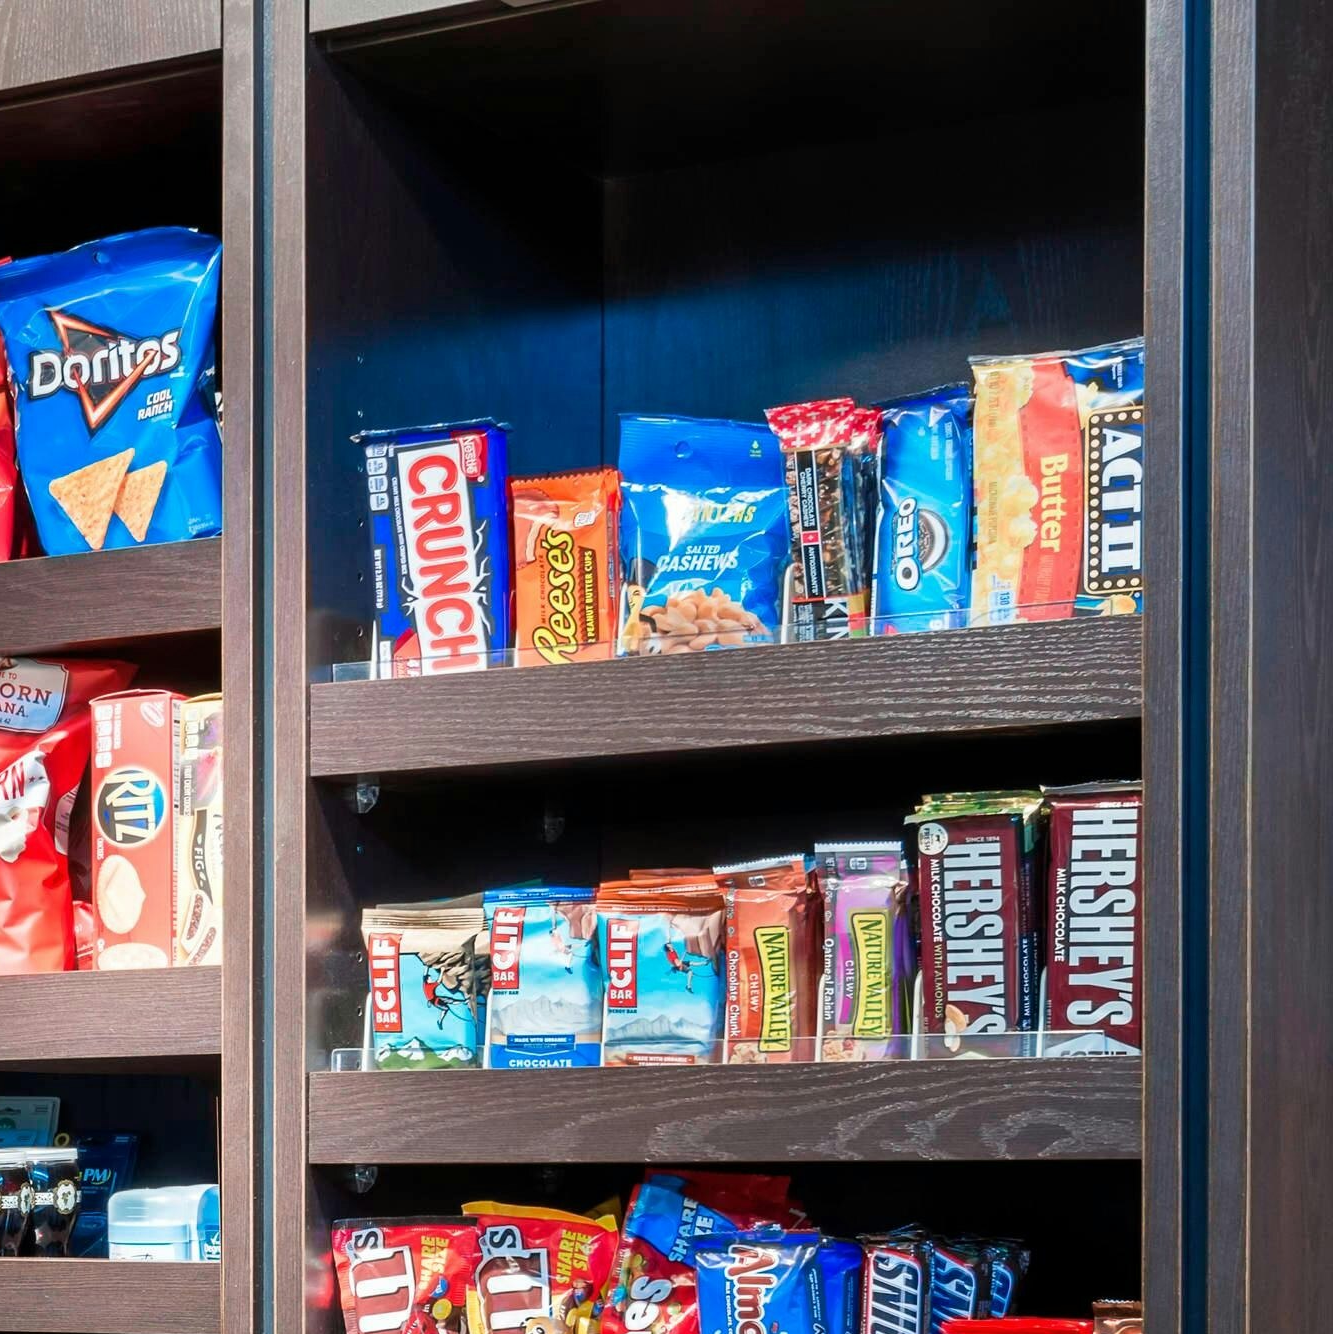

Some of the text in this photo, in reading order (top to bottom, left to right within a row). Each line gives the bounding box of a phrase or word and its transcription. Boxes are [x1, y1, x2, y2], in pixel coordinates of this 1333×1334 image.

[33, 329, 182, 396] Doritos
[137, 401, 174, 421] RANCH
[146, 389, 173, 405] COOL
[1040, 453, 1069, 553] Butter
[1101, 428, 1142, 518] ACT
[407, 453, 481, 672] CRUNCH
[657, 552, 738, 573] CASHEWS
[686, 544, 721, 555] SALTED
[895, 497, 921, 591] OREO
[533, 528, 579, 664] Reese's
[585, 550, 594, 636] PEANUT BUTTER CUPS
[824, 598, 849, 640] KIN
[105, 772, 156, 842] RITZ
[194, 846, 203, 872] FIG
[492, 909, 525, 971] CLIF
[930, 858, 944, 1019] MILK CHOCOLATE WITH ALMONDS
[943, 842, 1007, 1034] HERSHEY'S
[1054, 868, 1067, 963] MILK CHOCOLATE
[1066, 808, 1138, 1026] HERSHEY'S
[372, 937, 398, 1011] CLIF
[493, 970, 516, 983] BAR
[610, 920, 637, 989] CLIF
[823, 938, 835, 1021] Oatmeal Raisin
[844, 959, 855, 1000] CHEWY
[858, 918, 886, 1037] NATURE VALLEY
[1021, 937, 1031, 1017] MILK CHOCOLATE
[375, 1011, 398, 1024] BAR
[610, 989, 633, 1001] BAR
[728, 950, 740, 1037] Chocolate Chunk
[748, 973, 760, 1014] CHEWY
[761, 931, 788, 1049] NATURE VALLEY
[508, 1058, 573, 1068] CHOCOLATE
[84, 1168, 107, 1182] PM
[419, 1234, 436, 1290] SHARE
[432, 1236, 450, 1274] SIZE
[556, 1228, 579, 1284] SHARE
[573, 1232, 591, 1271] SIZE
[669, 1196, 700, 1263] SHARE
